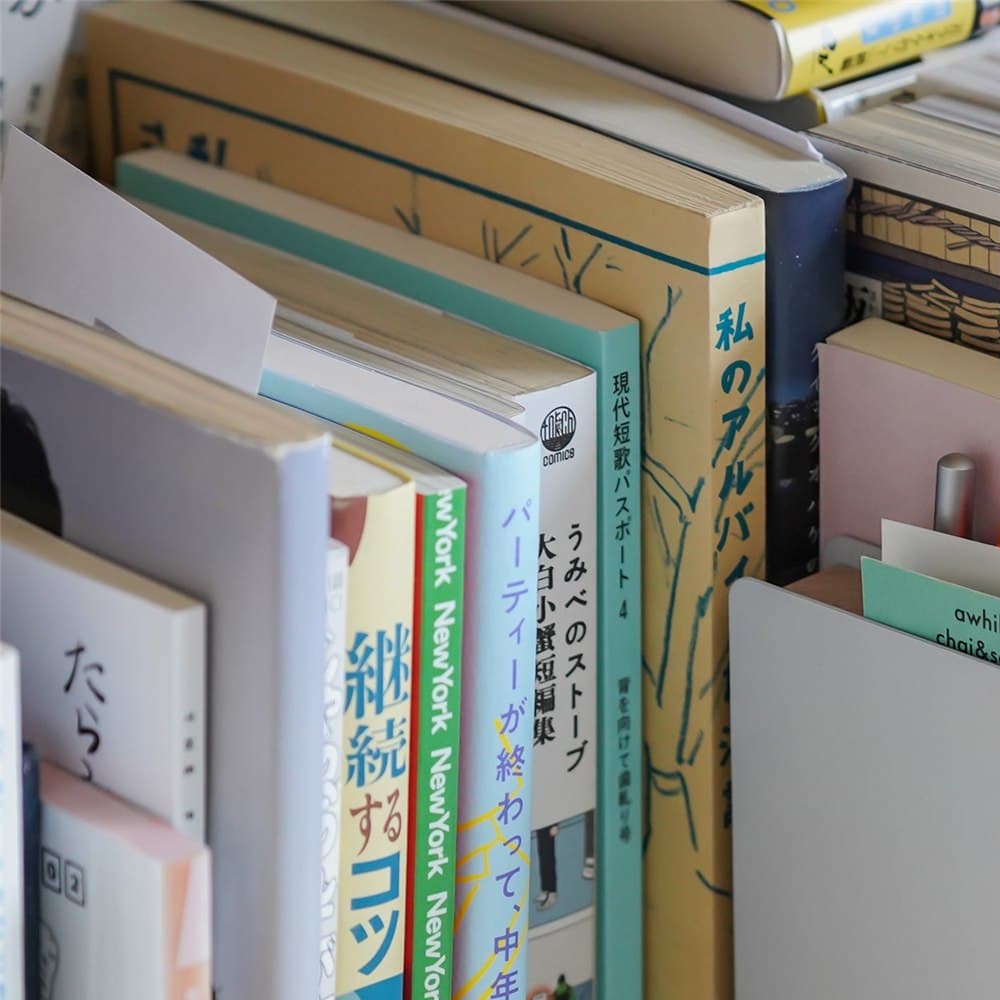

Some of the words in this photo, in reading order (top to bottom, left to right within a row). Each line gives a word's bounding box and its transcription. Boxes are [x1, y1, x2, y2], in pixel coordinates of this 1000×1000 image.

[613, 372, 632, 589] 現代短歌パスポート
[430, 600, 456, 735] NewYork
[564, 523, 588, 773] うみべのストーブ
[618, 600, 628, 620] 4
[344, 622, 411, 977] 継続するコツ
[427, 747, 452, 879] NewYork
